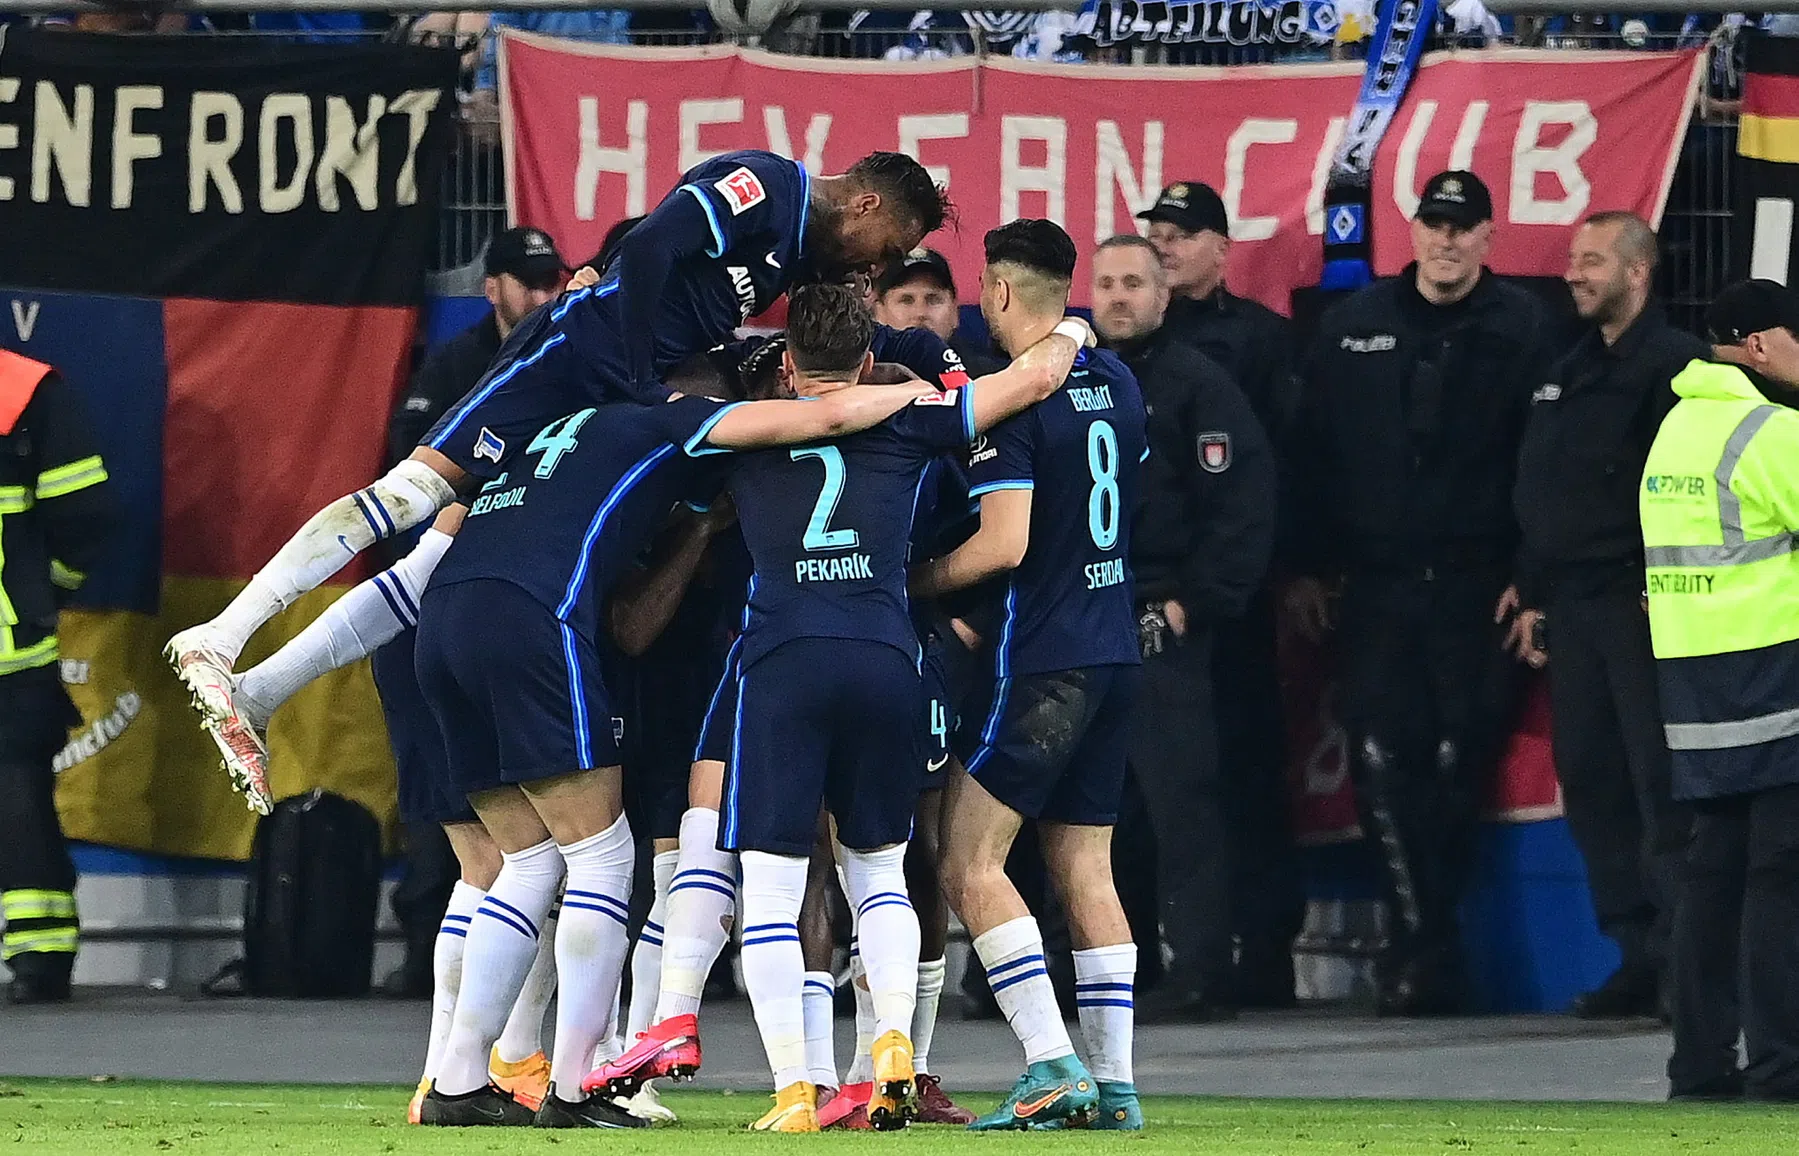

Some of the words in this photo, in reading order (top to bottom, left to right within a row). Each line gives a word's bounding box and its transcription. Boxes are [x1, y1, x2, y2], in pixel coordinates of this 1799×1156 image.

[789, 445, 860, 552] 2
[1087, 419, 1121, 551] 8
[795, 552, 874, 583] PEKARÍK
[931, 699, 948, 749] 4
